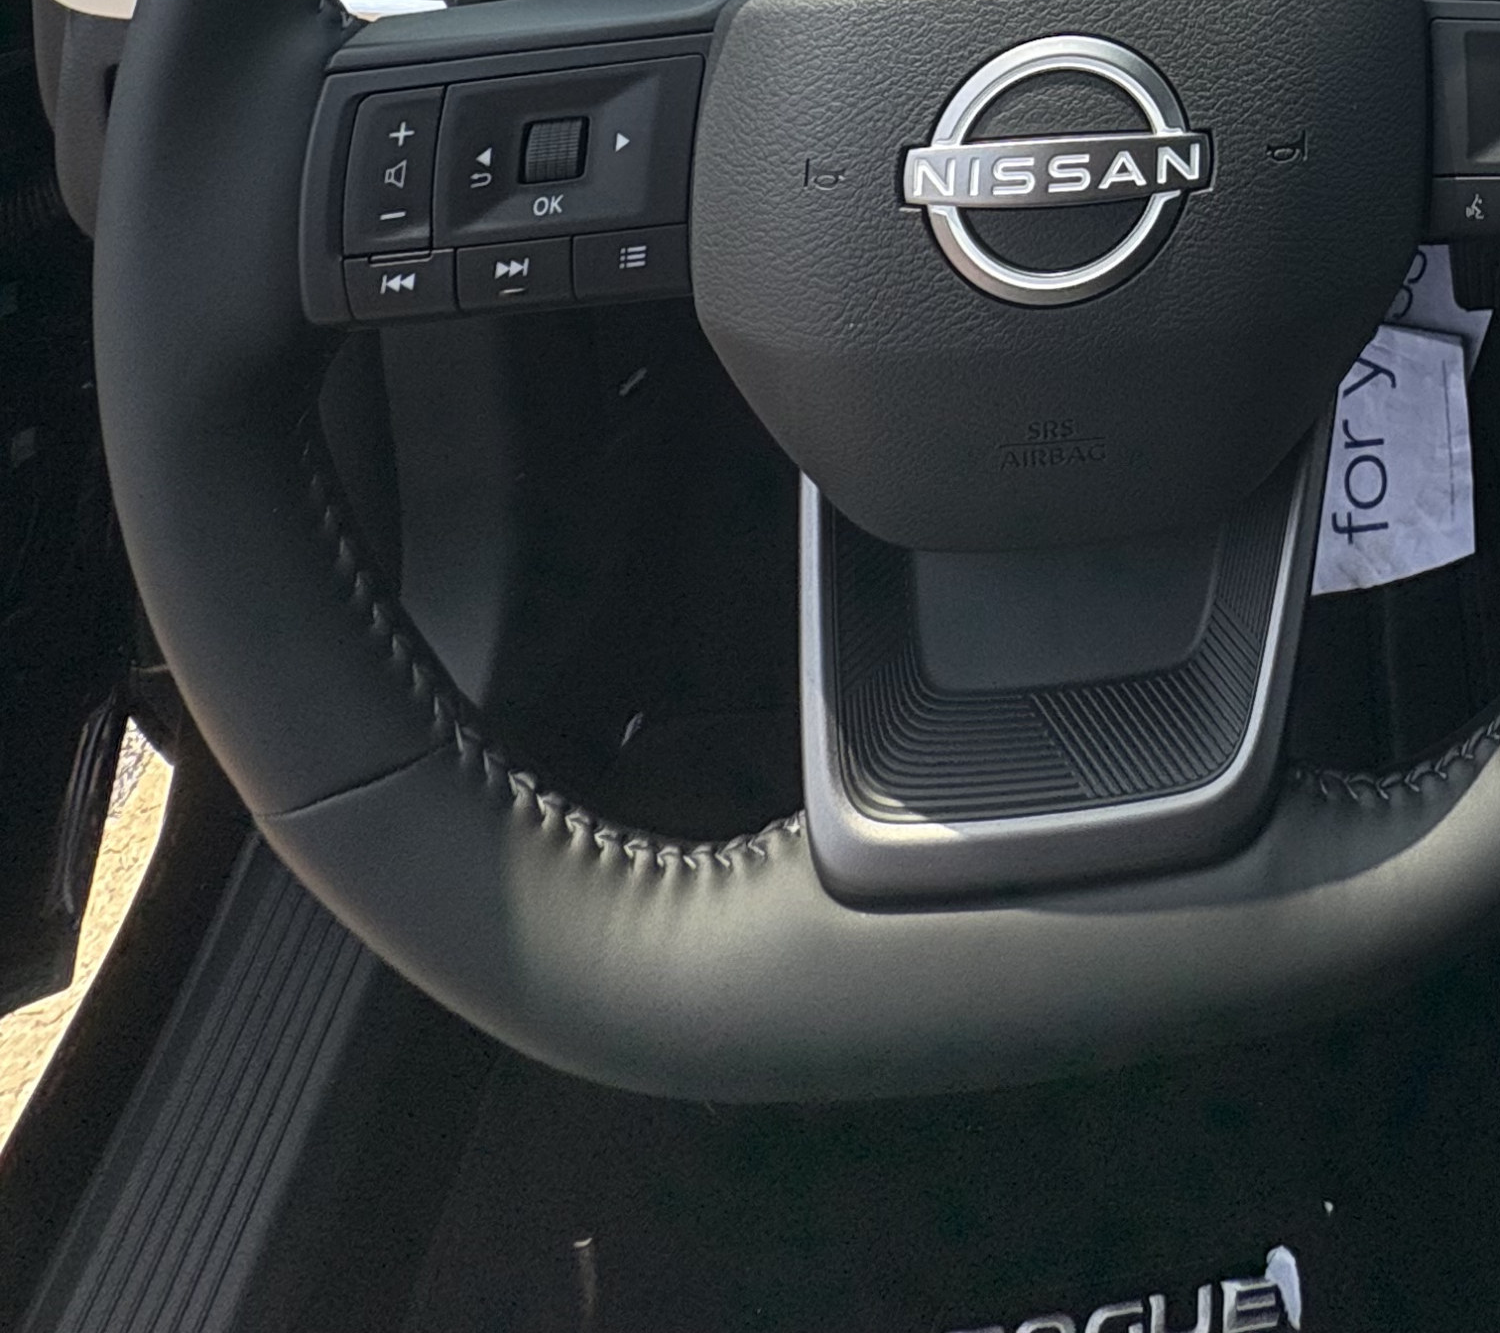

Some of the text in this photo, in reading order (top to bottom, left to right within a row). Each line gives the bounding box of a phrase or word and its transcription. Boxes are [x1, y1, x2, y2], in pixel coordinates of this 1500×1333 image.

[911, 140, 1201, 199] NISSAN
[532, 193, 565, 217] OK
[1027, 417, 1075, 441] SRS
[1000, 443, 1107, 471] AIRBAG
[1332, 418, 1389, 547] for
[943, 1279, 1281, 1333] GUE
